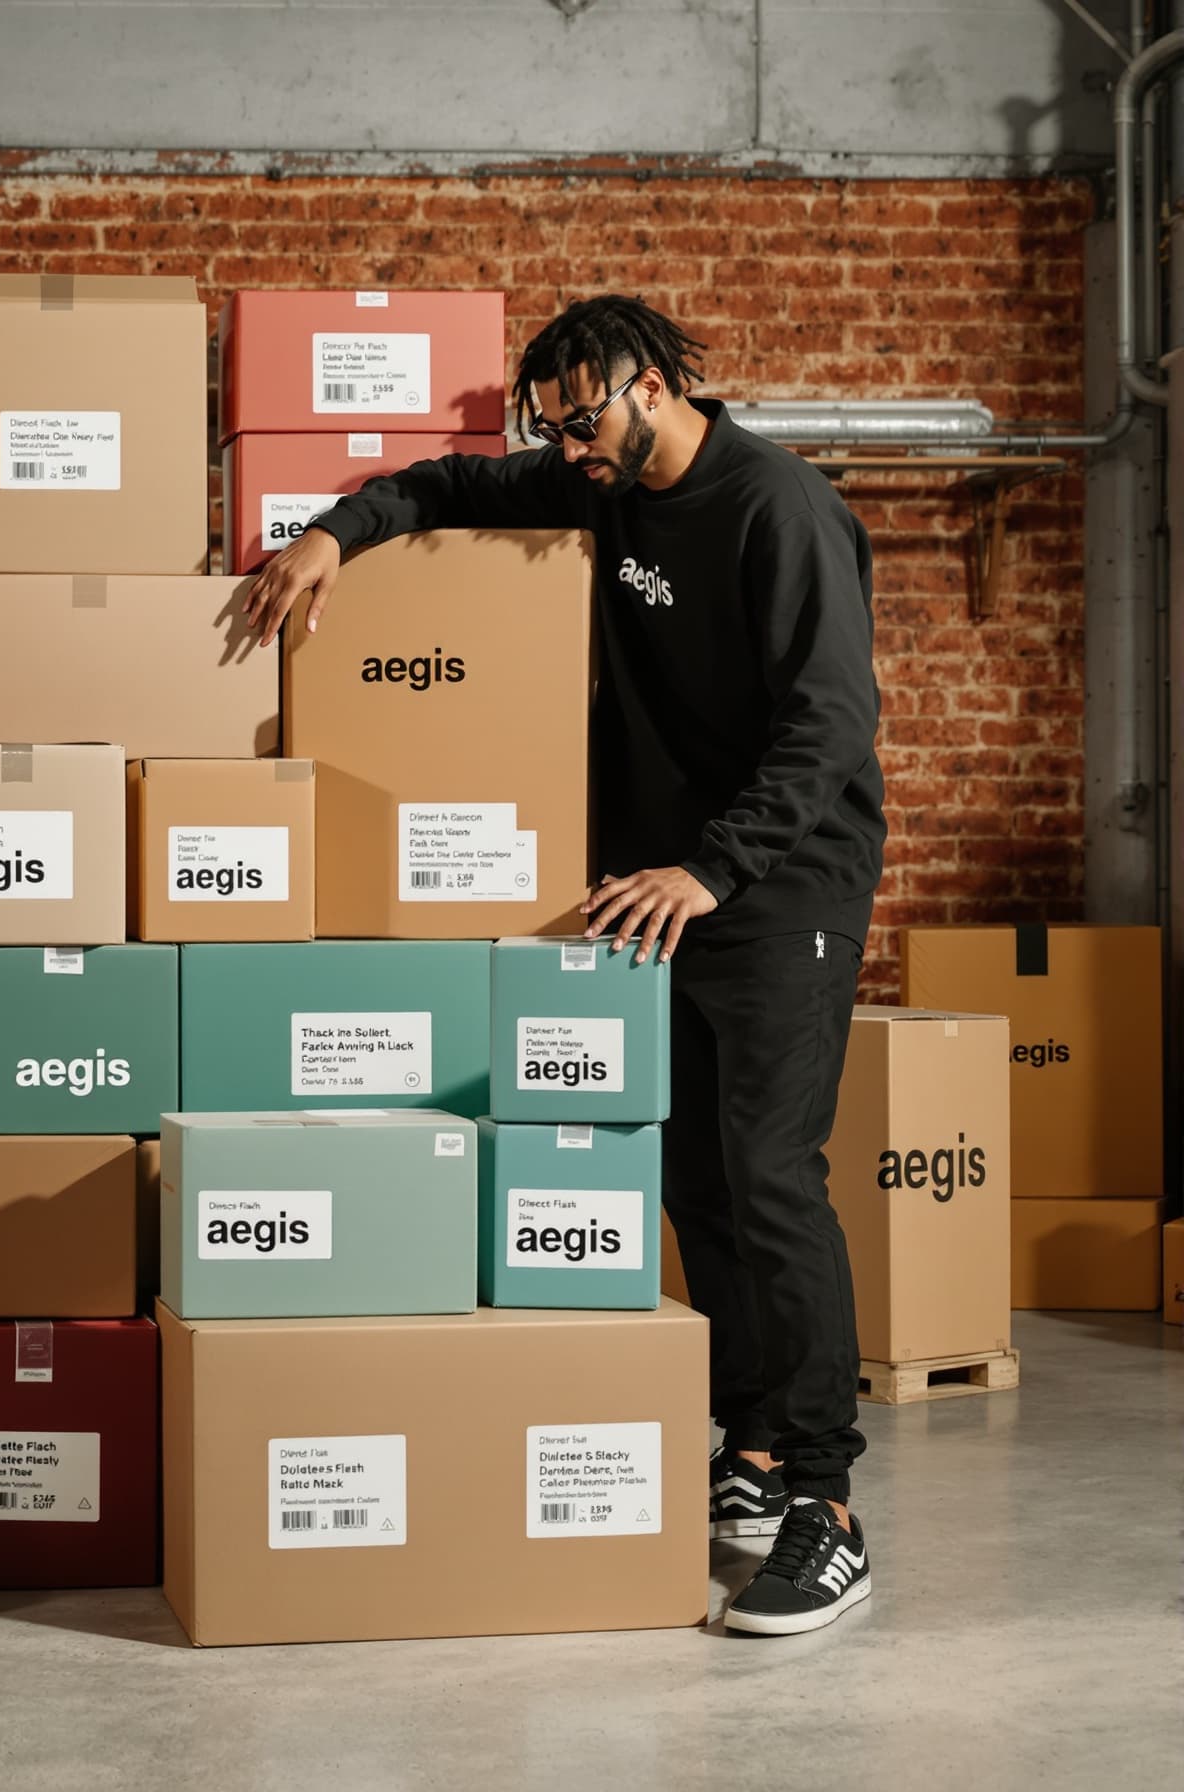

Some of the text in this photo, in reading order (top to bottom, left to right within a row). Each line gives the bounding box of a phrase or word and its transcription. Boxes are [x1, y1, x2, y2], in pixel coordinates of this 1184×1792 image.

[619, 557, 673, 606] aegis
[362, 648, 465, 691] aegis
[177, 861, 262, 895] aegis
[16, 1048, 130, 1096] aegis
[525, 1053, 607, 1086] aegis
[1009, 1038, 1069, 1067] egis
[878, 1132, 986, 1202] aegis
[207, 1211, 309, 1252] aegis
[516, 1219, 620, 1261] aegis
